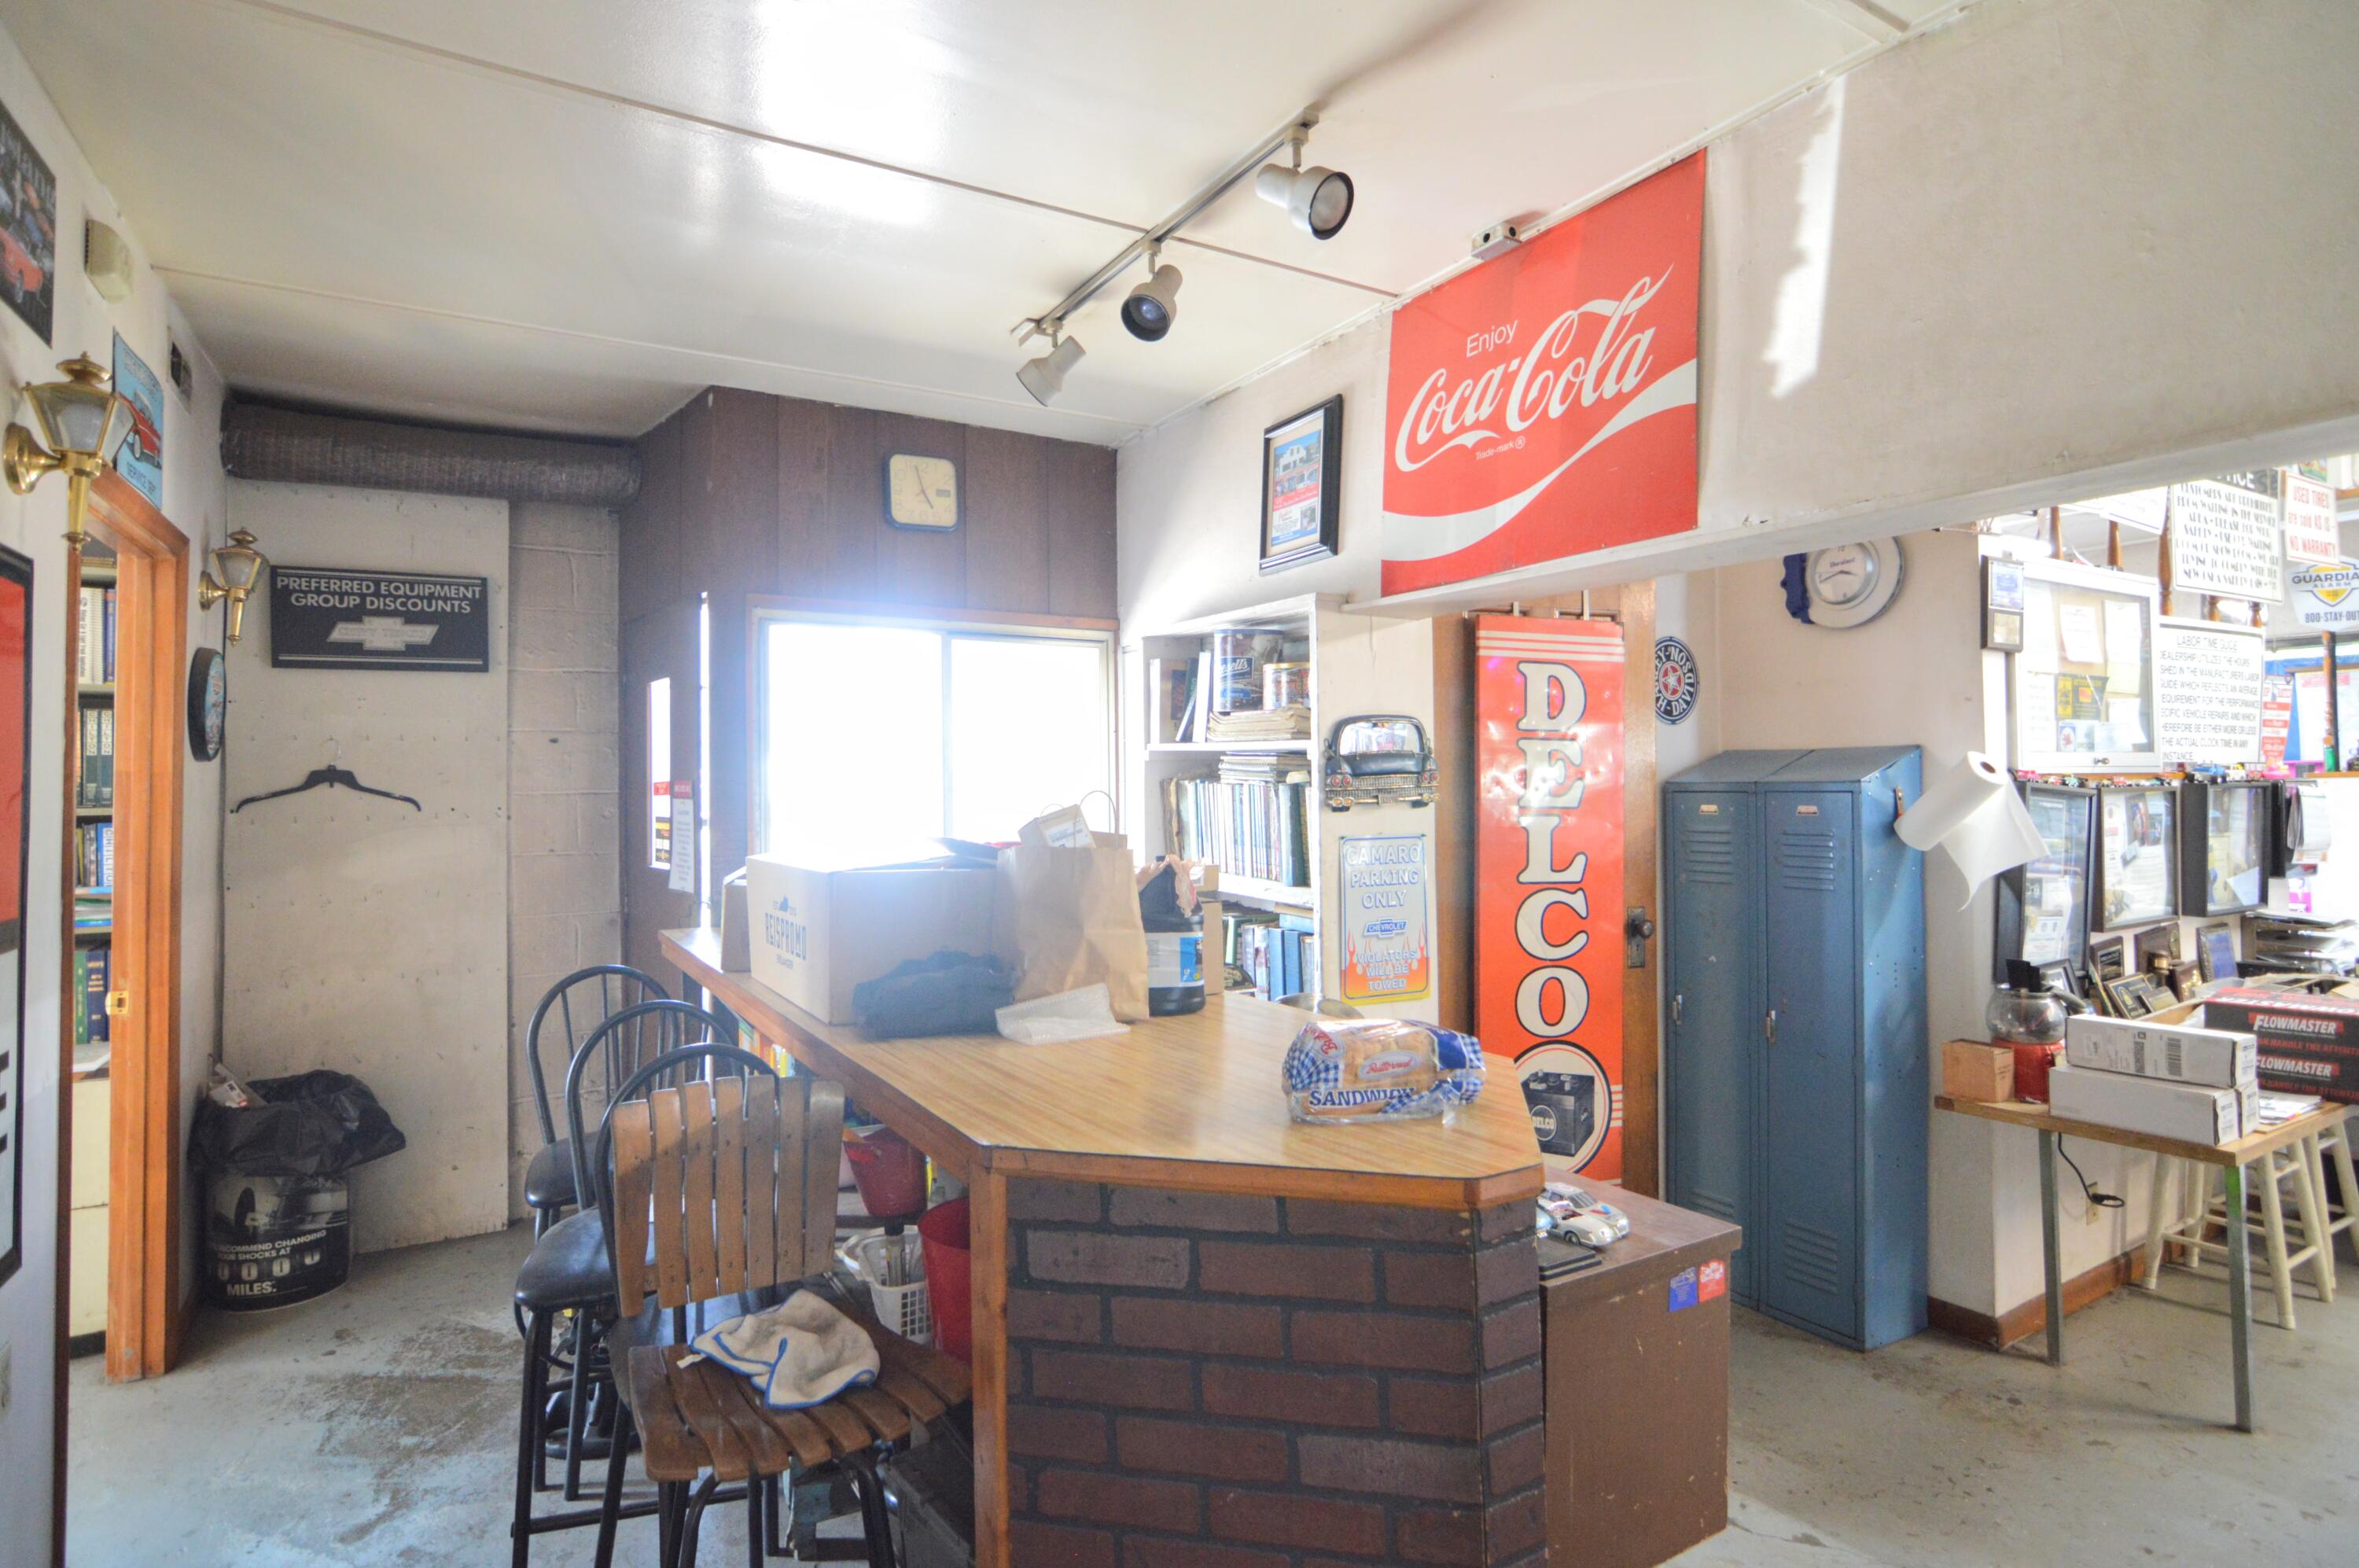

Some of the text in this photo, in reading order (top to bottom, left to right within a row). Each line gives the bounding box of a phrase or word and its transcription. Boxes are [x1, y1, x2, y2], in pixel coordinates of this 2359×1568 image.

[1466, 320, 1518, 358] Enjoy
[1395, 266, 1673, 472] Coca-Cola
[1475, 440, 1514, 461] Trade-mark
[2226, 471, 2255, 489] TICE
[2293, 485, 2329, 510] USED TIRES
[2314, 514, 2322, 531] AS
[2289, 535, 2336, 558] NO WARRANTY
[2291, 572, 2359, 584] GUARDIA
[277, 576, 482, 599] PREFERRED EQUIPMENT
[291, 593, 472, 613] GROUP DISCOUNTS
[2177, 635, 2202, 647] LABOR
[2203, 637, 2219, 649] TIME
[2179, 666, 2185, 675] IN
[2186, 667, 2199, 676] THE
[2161, 694, 2201, 705] EQUIREMENT
[2203, 696, 2214, 705] FOR
[2161, 708, 2181, 718] ECIFIC
[2182, 709, 2206, 719] VEHICLE
[2162, 722, 2193, 733] HEREFORE
[2194, 723, 2202, 733] BE
[2161, 737, 2173, 747] THE
[2176, 737, 2199, 748] ACTUAL
[2220, 739, 2232, 749] TIME
[2162, 751, 2194, 761] INSTANCE
[1345, 843, 1422, 866] CAMARO
[1514, 661, 1590, 1038] DELCO
[1350, 869, 1419, 889] PARKING
[1362, 889, 1407, 911] ONLY
[1367, 922, 1406, 933] CHEVROLET
[1356, 949, 1417, 965] VIOLATORS
[1365, 963, 1409, 978] WILL BE
[1367, 978, 1407, 992] TOWED
[2253, 1014, 2337, 1034] FLOWMASTER
[2256, 1056, 2332, 1077] FLOWMASTER
[275, 1230, 327, 1248] CHANGING
[238, 1250, 278, 1261] SHOCKS
[279, 1247, 291, 1257] AT
